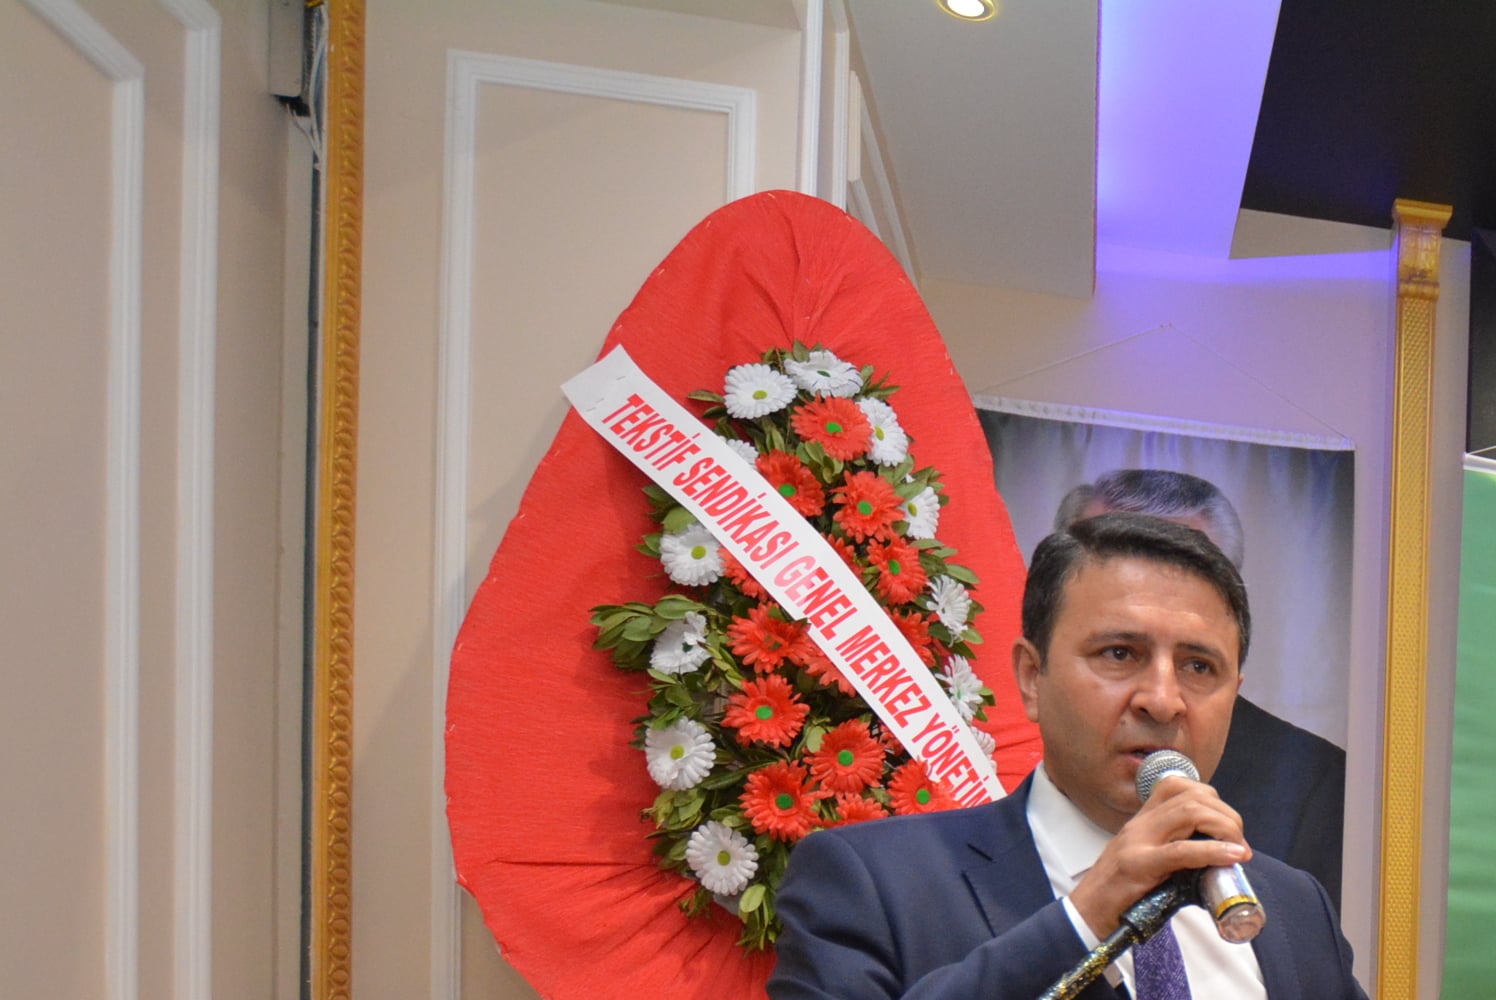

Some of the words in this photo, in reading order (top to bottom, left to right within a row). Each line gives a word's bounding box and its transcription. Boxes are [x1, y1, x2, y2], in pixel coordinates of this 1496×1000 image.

[601, 393, 702, 471] TEKSTİF
[672, 456, 799, 570] SENDİKASI
[774, 555, 858, 641] GENEL
[835, 625, 932, 729] MERKEZ
